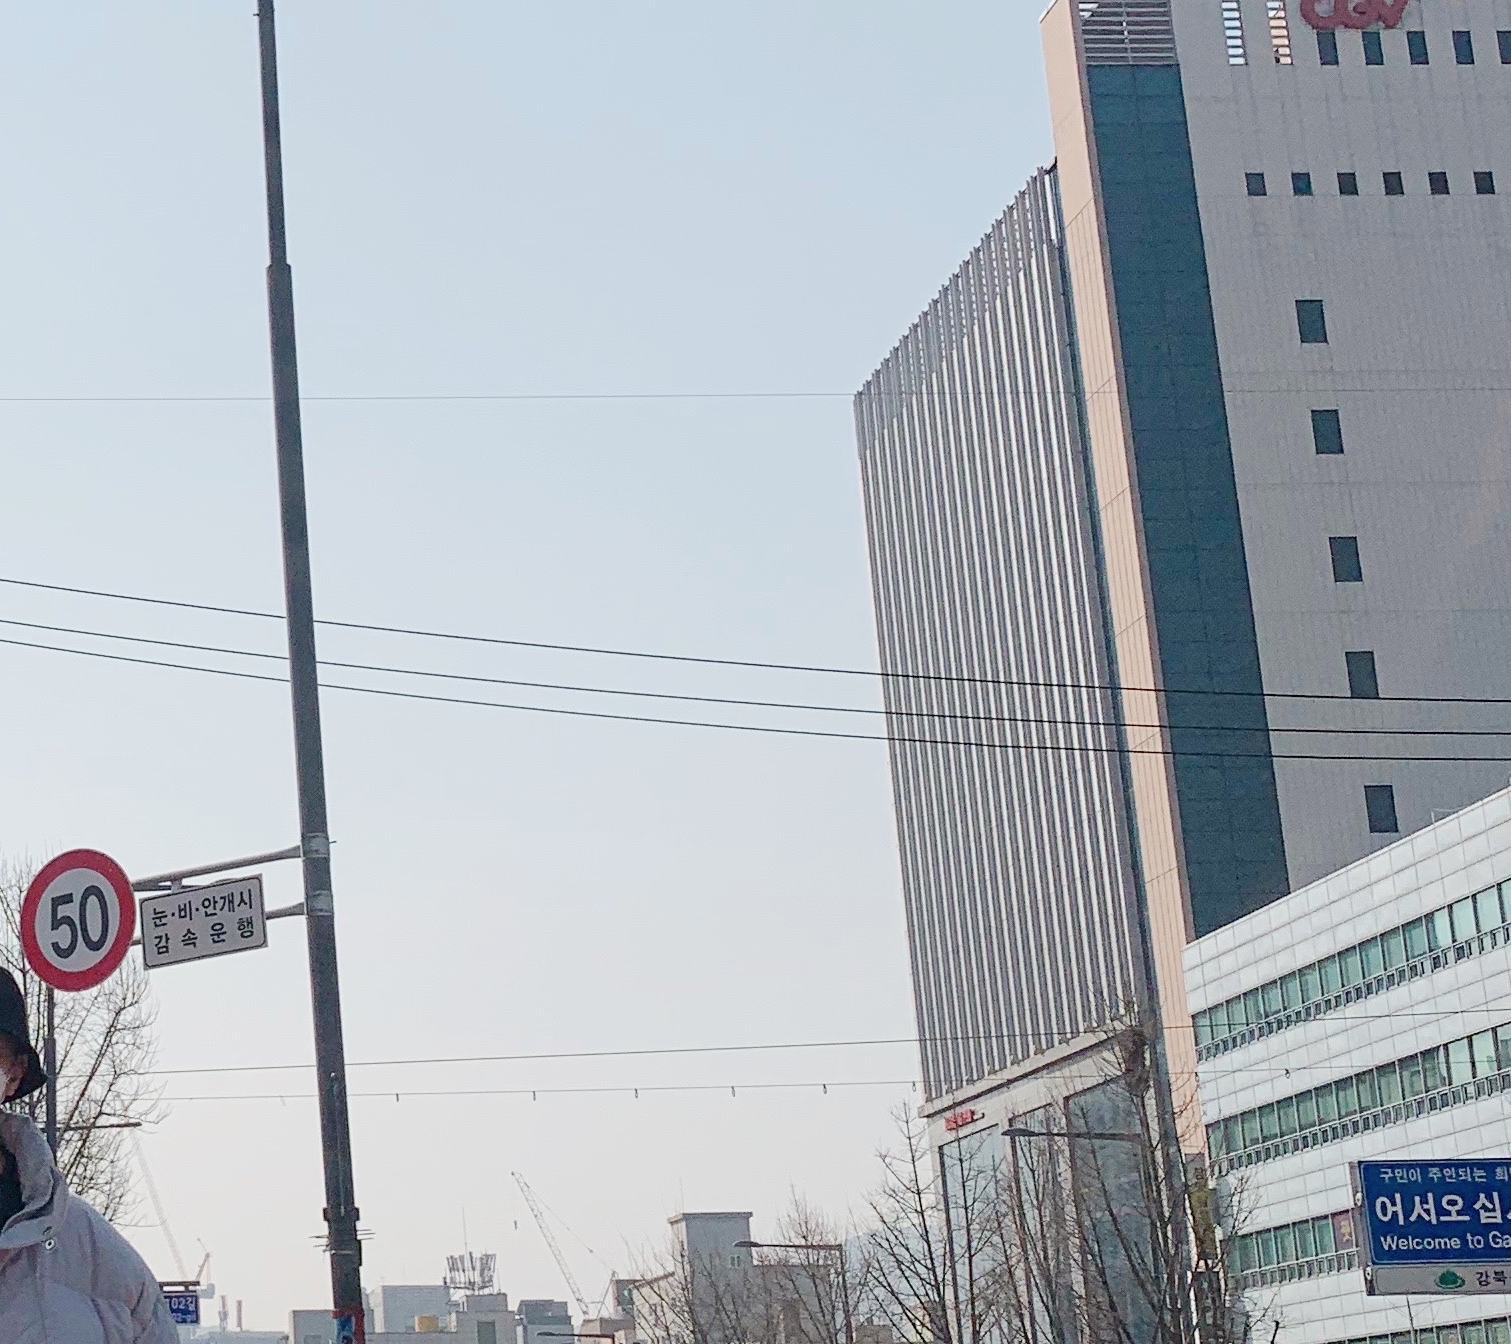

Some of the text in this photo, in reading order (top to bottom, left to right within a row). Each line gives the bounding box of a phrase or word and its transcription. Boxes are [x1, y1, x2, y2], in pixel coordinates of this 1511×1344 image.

[50, 885, 109, 959] 50
[1379, 1165, 1511, 1184] 구민이 주인되는 희
[1375, 1191, 1511, 1225] 어서오십
[1380, 1234, 1461, 1251] Welcome
[1466, 1232, 1484, 1249] to
[1476, 1269, 1511, 1287] 강북
